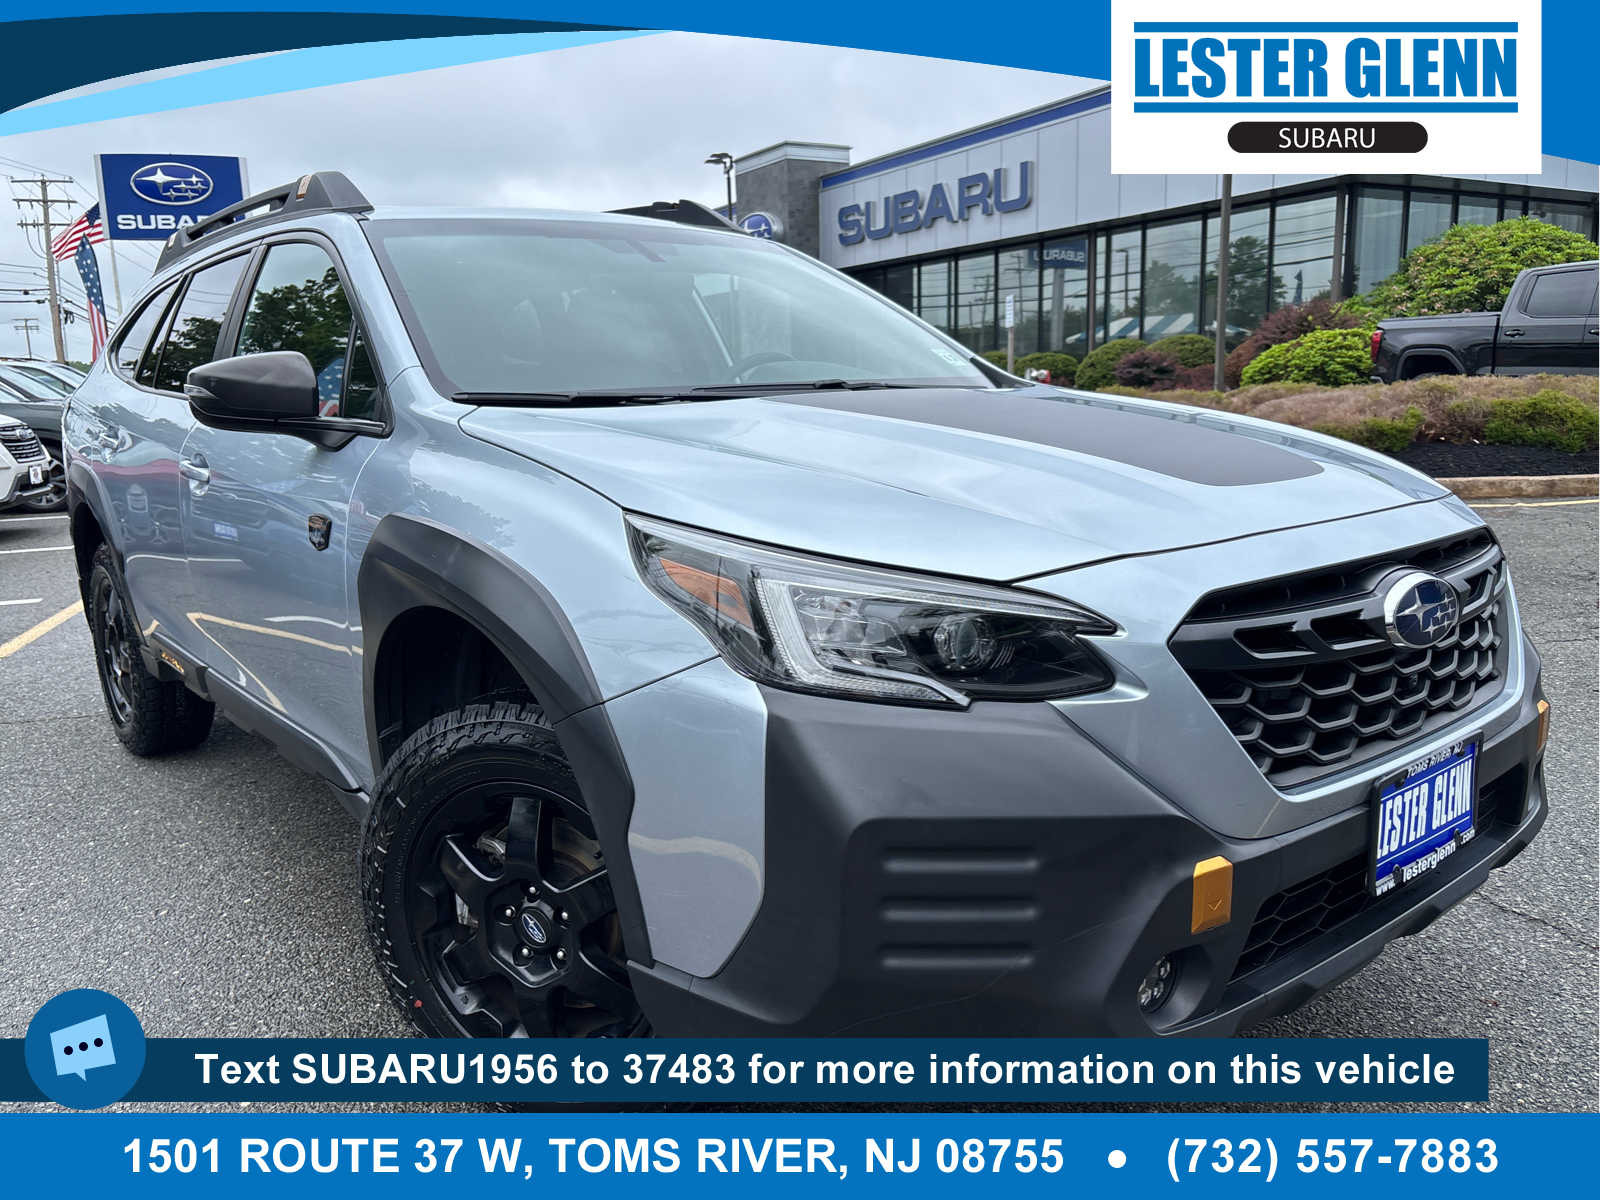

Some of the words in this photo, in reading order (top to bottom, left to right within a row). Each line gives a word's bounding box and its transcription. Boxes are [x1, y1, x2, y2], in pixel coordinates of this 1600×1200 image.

[116, 214, 210, 230] SUBA
[838, 161, 1033, 246] SUBARU
[1407, 758, 1430, 778] TOMS
[1377, 782, 1428, 859] LESTER
[1432, 759, 1473, 830] GLENN
